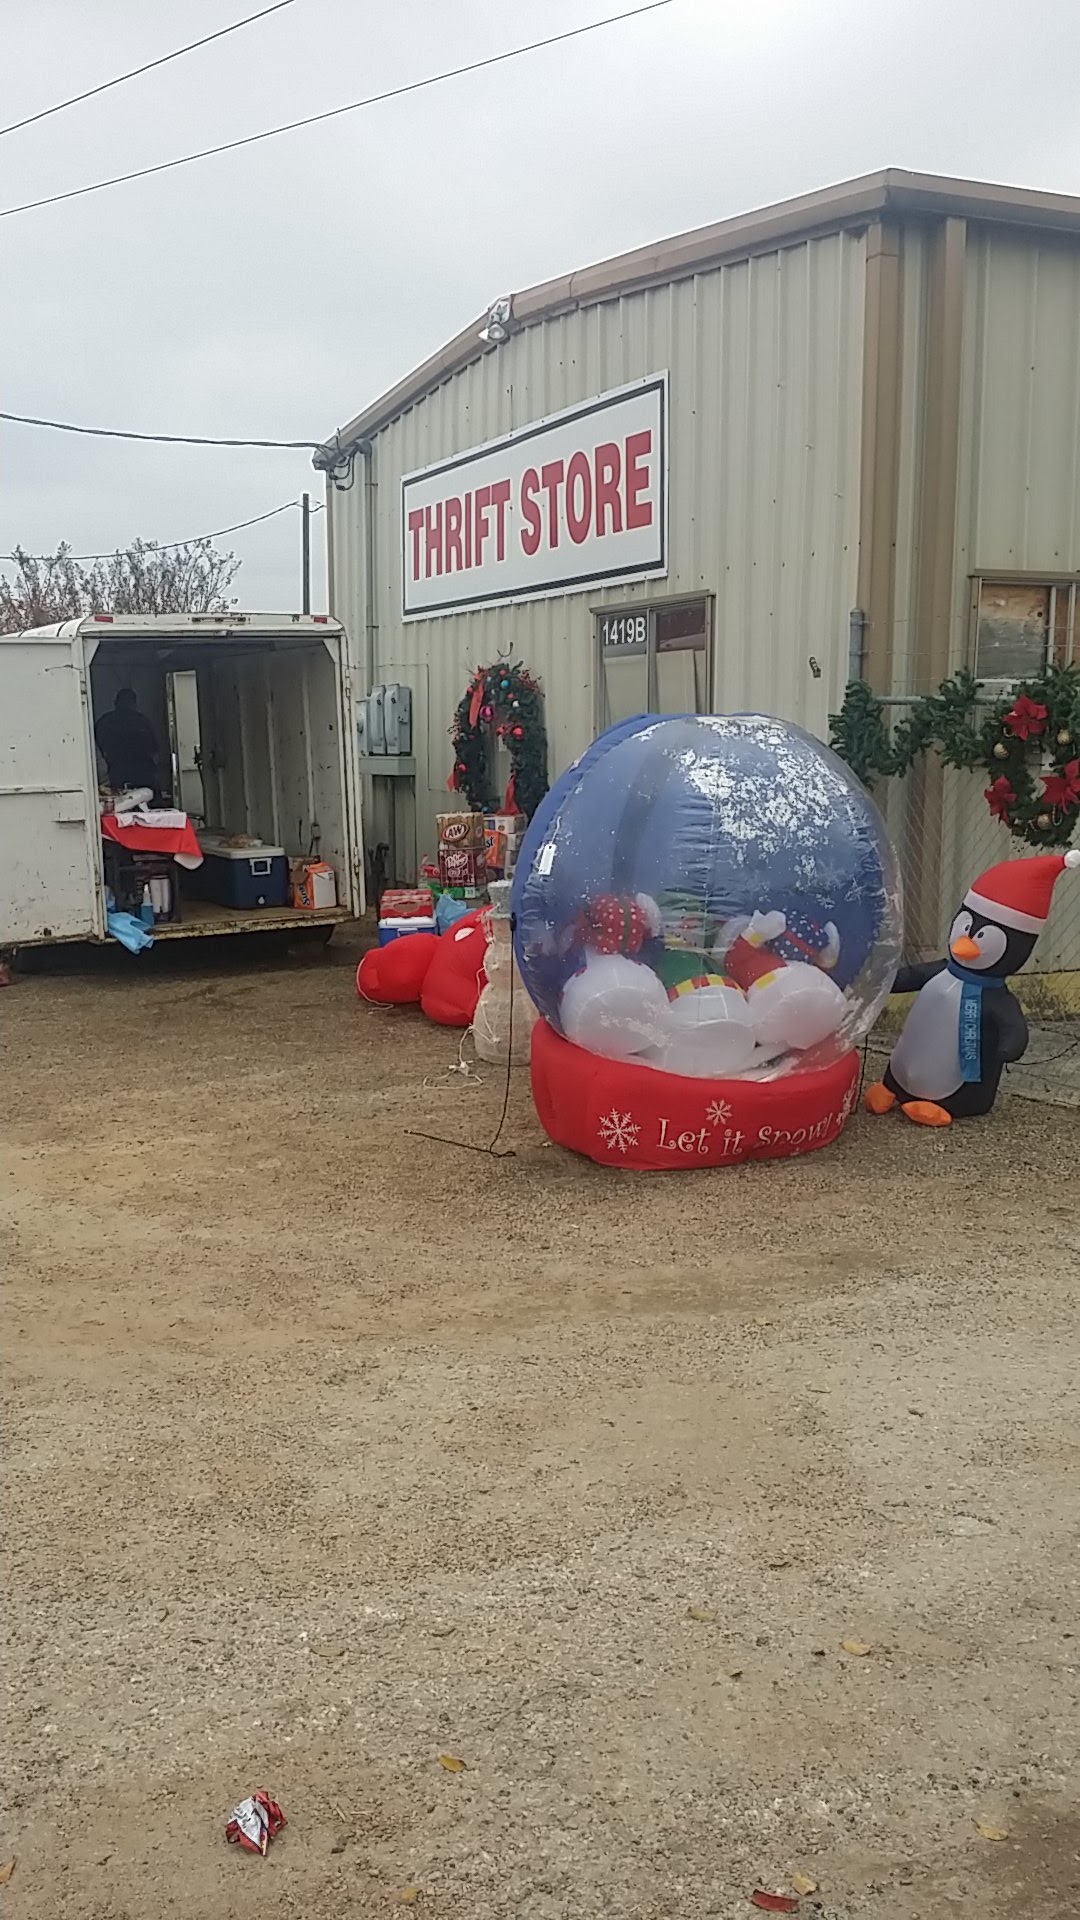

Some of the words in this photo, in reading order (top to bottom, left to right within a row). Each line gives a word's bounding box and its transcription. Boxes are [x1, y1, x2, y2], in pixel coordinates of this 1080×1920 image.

[408, 478, 511, 581] THRIFT
[520, 429, 653, 556] STORE
[603, 616, 645, 645] 1419B
[656, 1118, 712, 1155] Let
[720, 1129, 745, 1156] it
